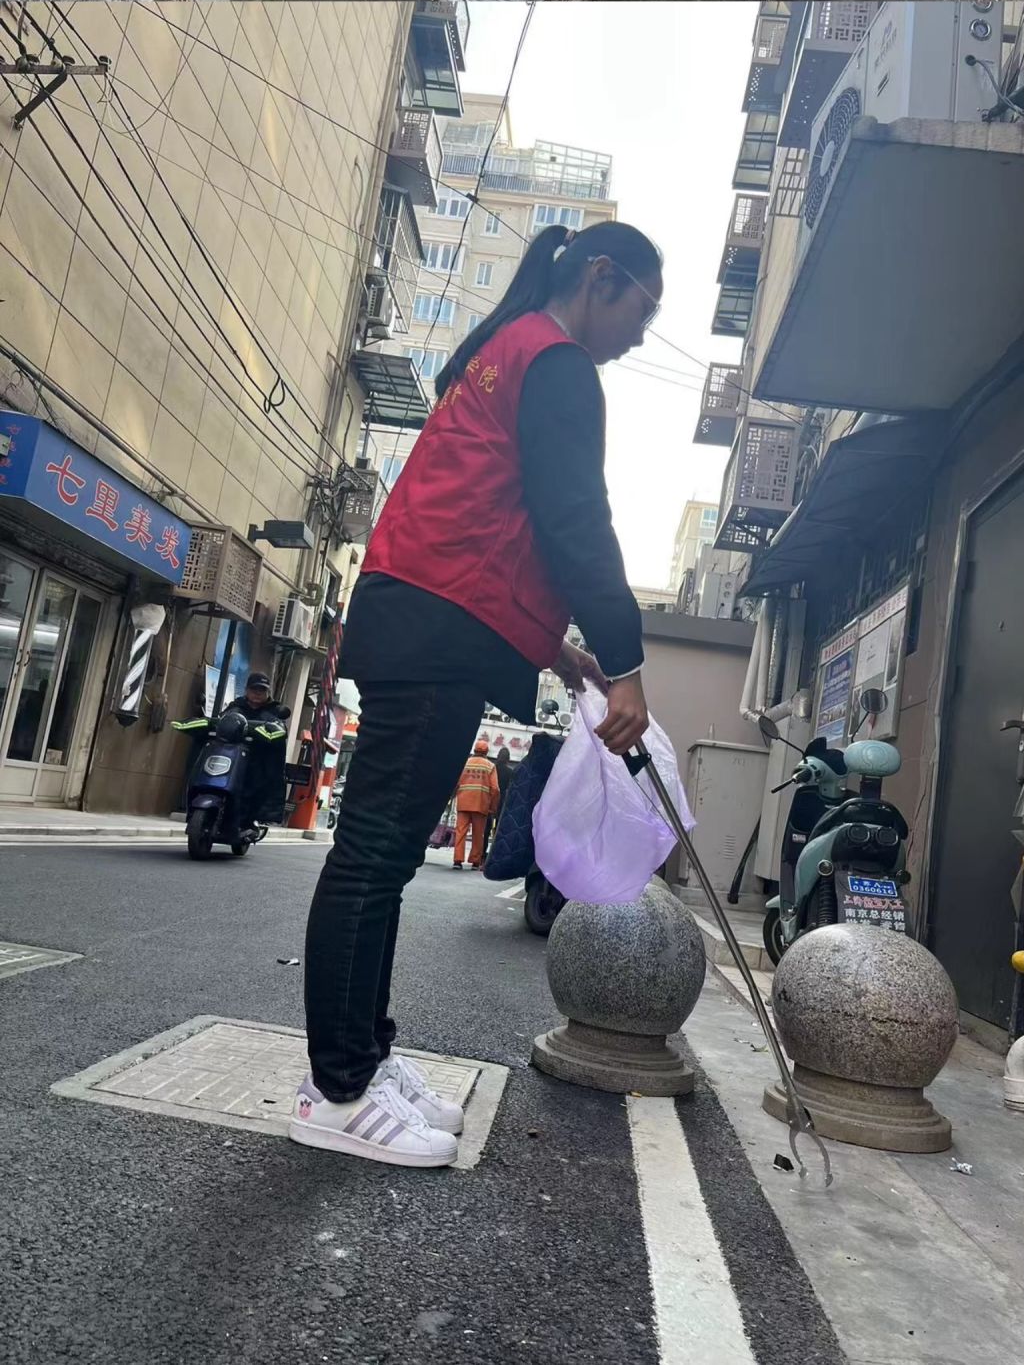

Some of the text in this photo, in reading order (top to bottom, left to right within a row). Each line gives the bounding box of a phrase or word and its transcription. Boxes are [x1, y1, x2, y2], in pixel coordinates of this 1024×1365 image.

[45, 454, 181, 570] 七里美发
[844, 908, 905, 922] 南京总经销
